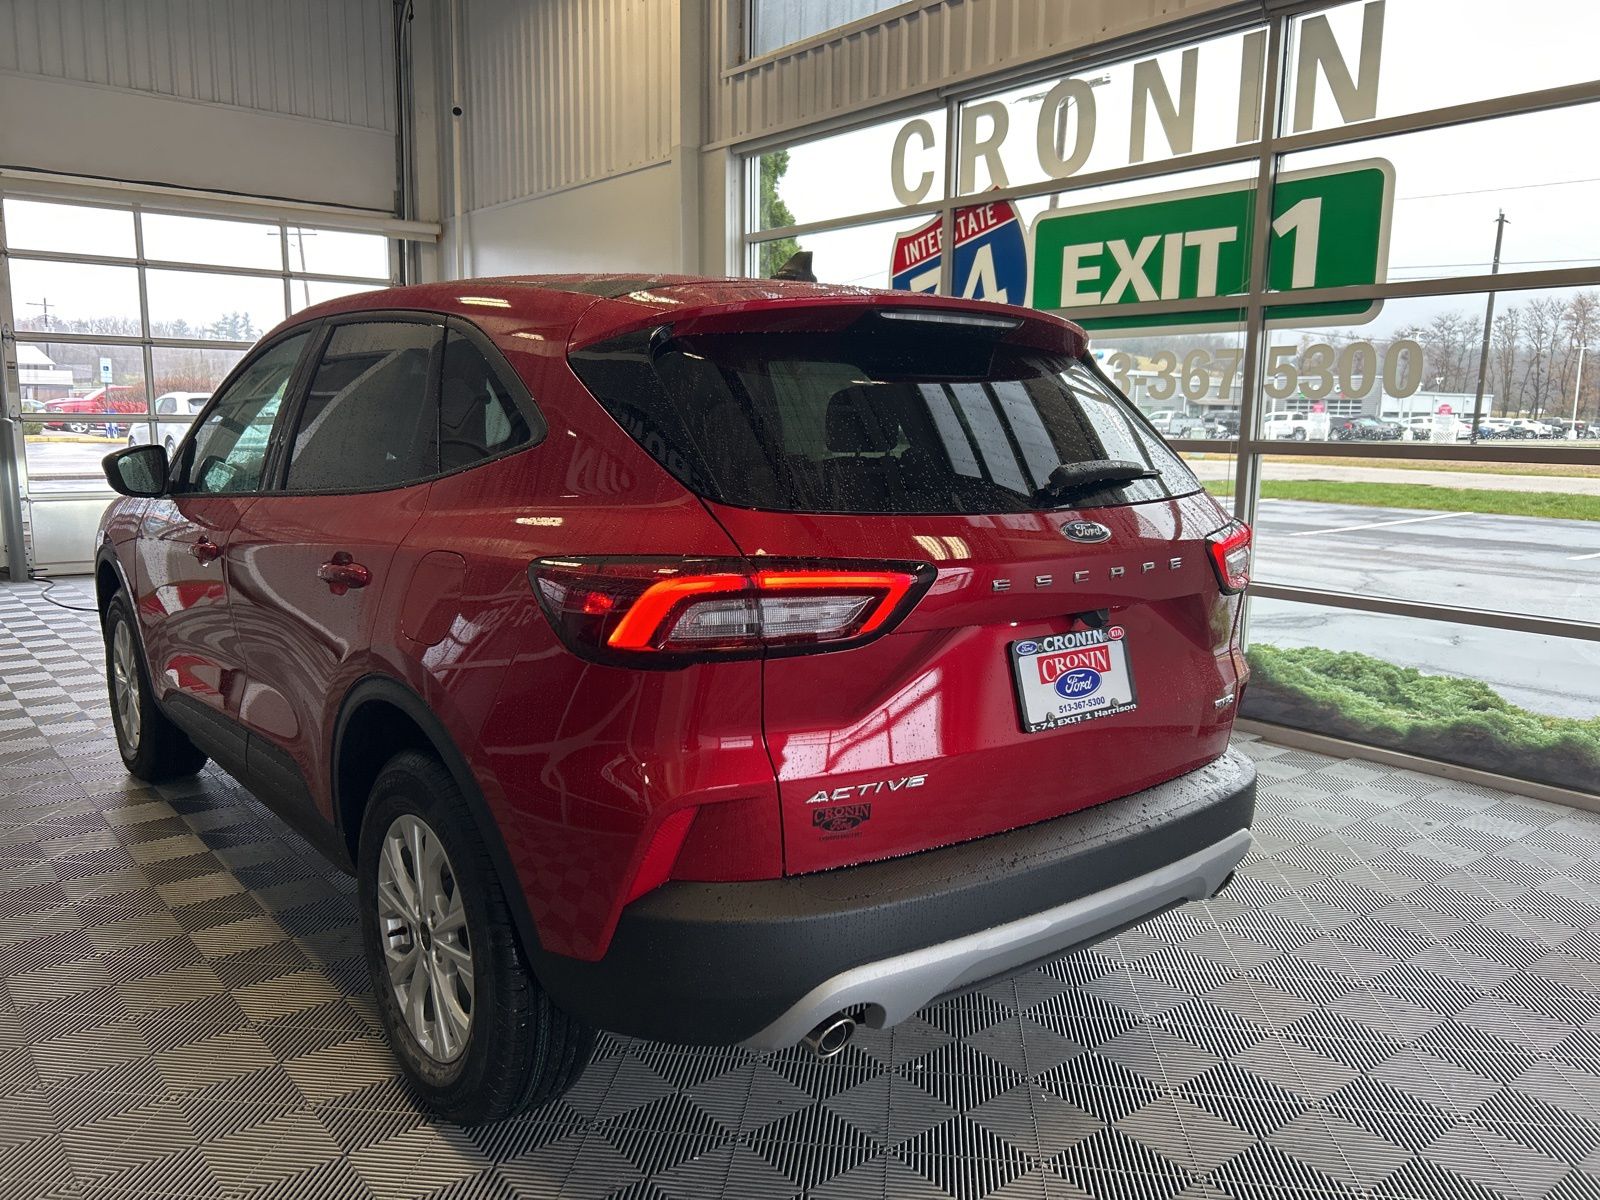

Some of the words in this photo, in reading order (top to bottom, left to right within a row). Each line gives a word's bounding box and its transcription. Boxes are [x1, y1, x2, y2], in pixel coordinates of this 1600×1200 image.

[891, 0, 1386, 206] CRONIN
[1061, 226, 1238, 307] EXIT
[1272, 197, 1324, 290] 1
[1074, 523, 1103, 537] Ford
[992, 557, 1184, 591] ESCAPE
[1043, 629, 1104, 652] CRONIN
[1110, 629, 1122, 639] KIA
[1042, 649, 1110, 682] CRONIN
[1065, 673, 1093, 694] Ford
[1030, 720, 1056, 733] I-74
[1057, 715, 1083, 727] EXIT
[1085, 713, 1092, 721] 1
[1094, 703, 1137, 718] Harrison
[1058, 697, 1106, 714] 513-367-5300
[806, 773, 929, 804] ACTIVE
[813, 805, 871, 823] CRONIN
